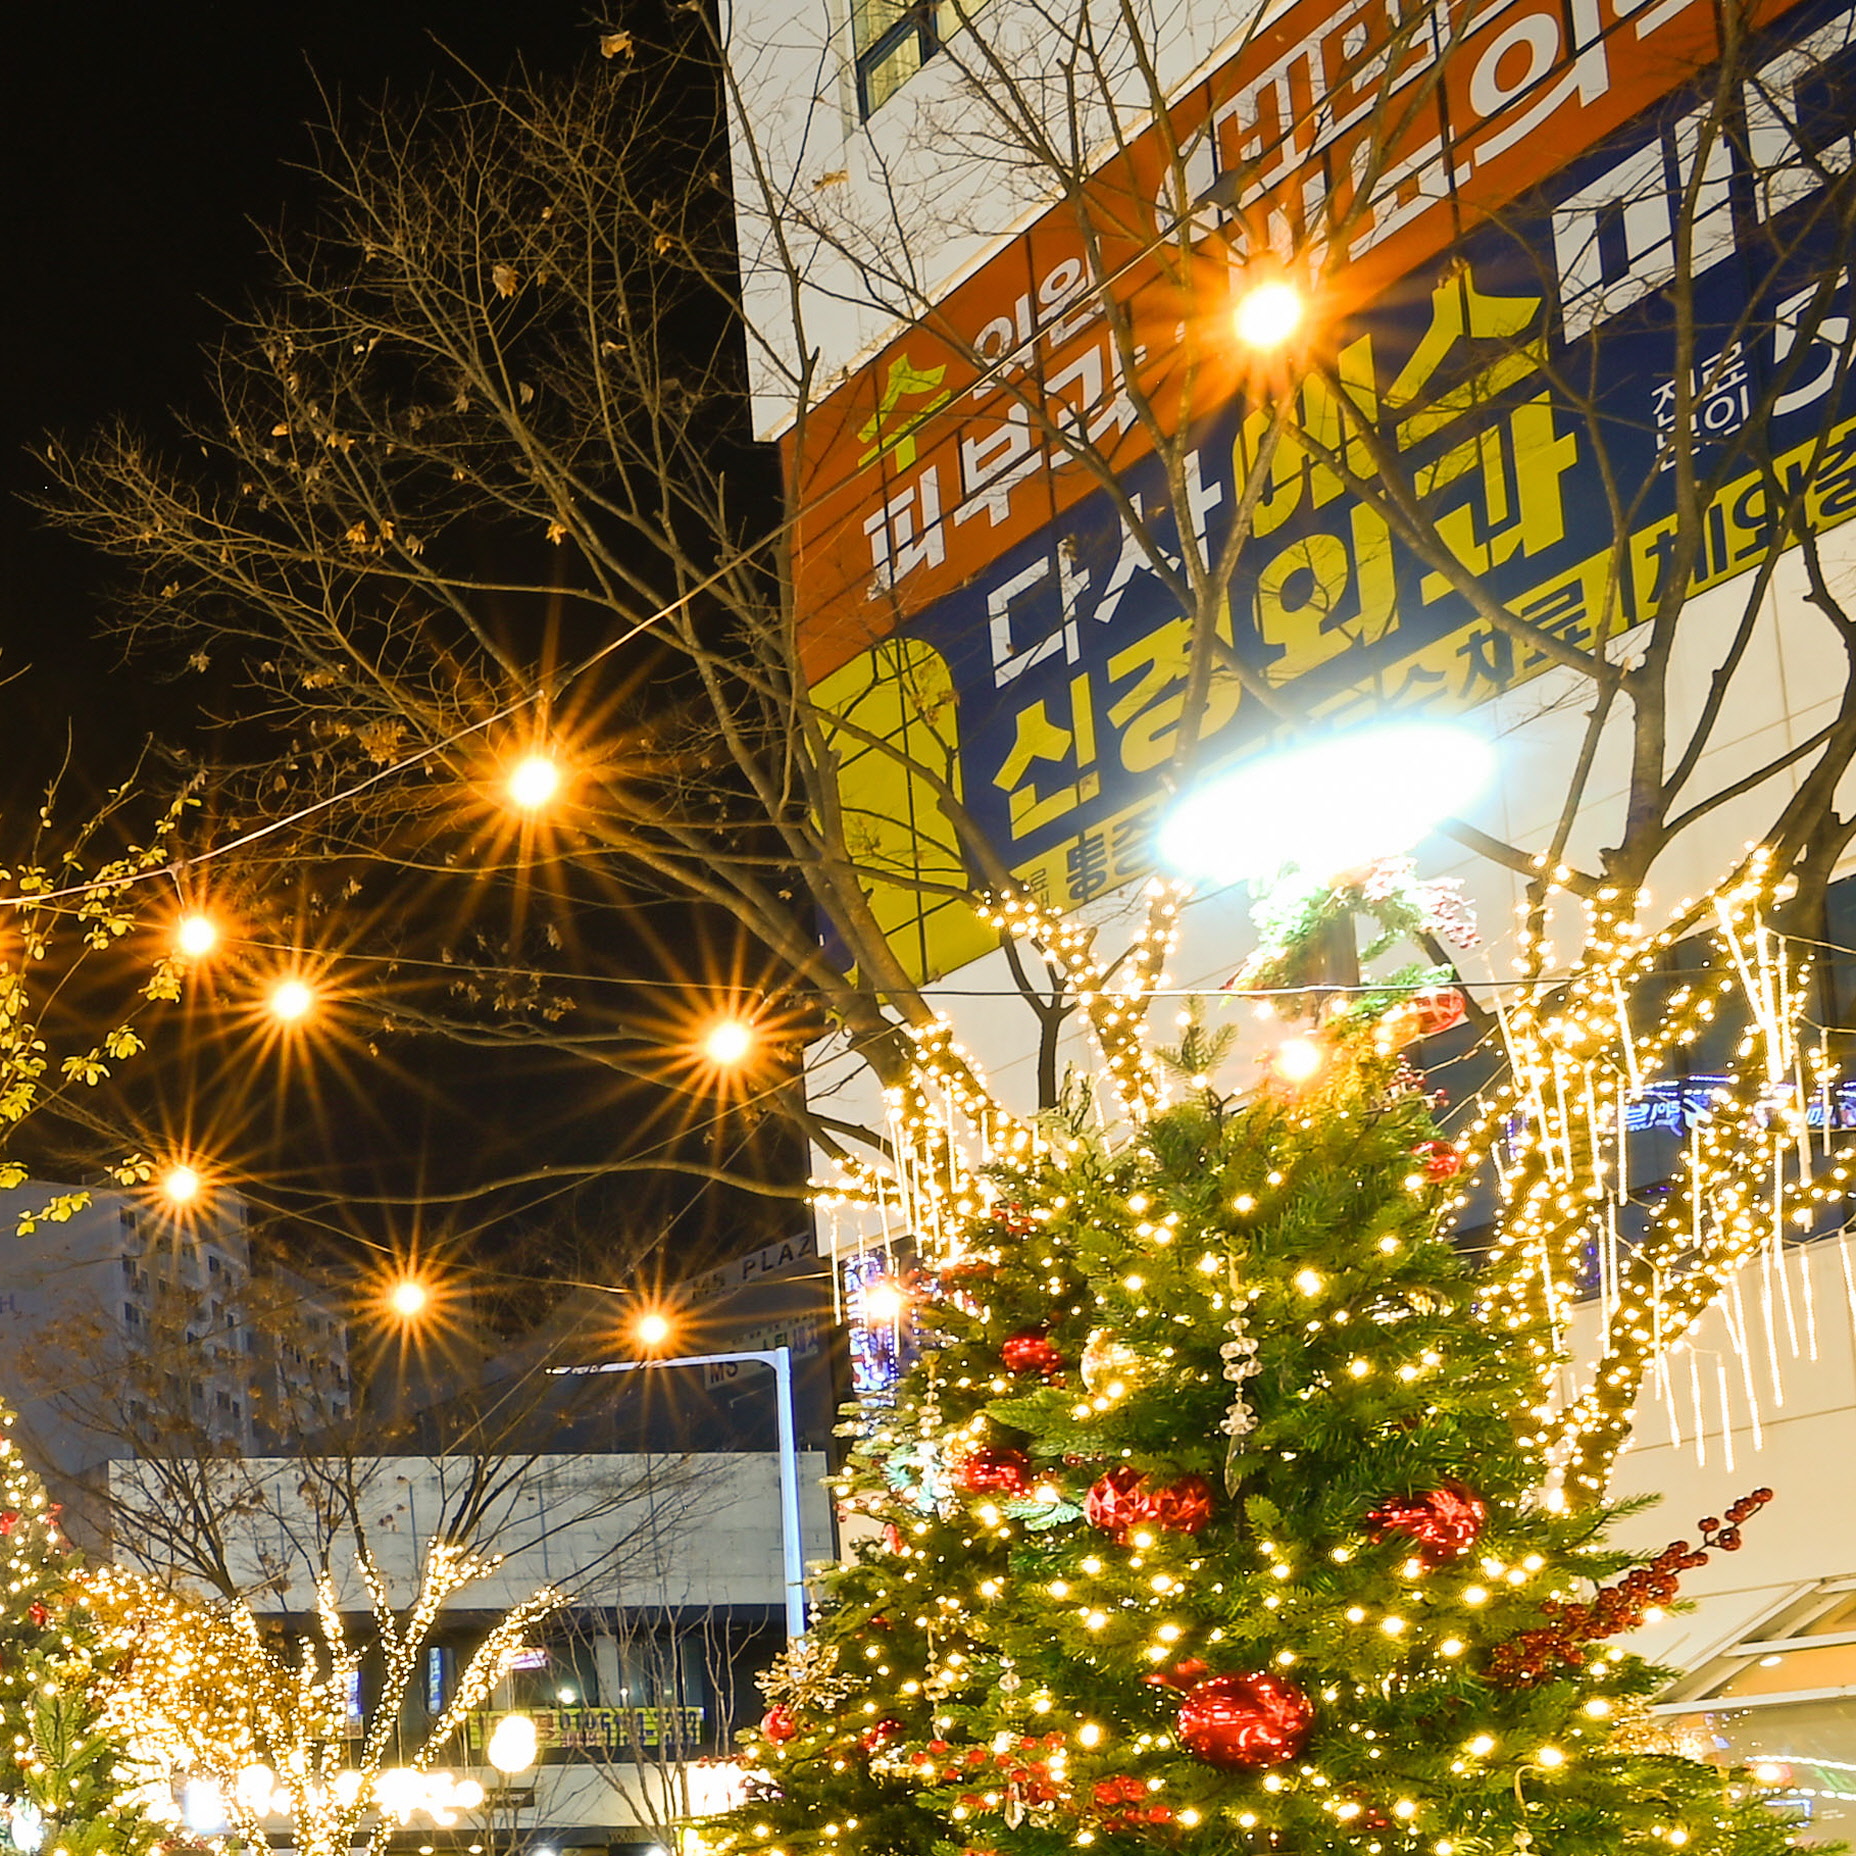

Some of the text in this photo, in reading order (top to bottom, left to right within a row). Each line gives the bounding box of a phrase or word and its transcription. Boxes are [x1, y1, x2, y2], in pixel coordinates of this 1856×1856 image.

[858, 353, 947, 474] 수
[864, 330, 1147, 601] 피부과
[992, 391, 1578, 842] 신경외과
